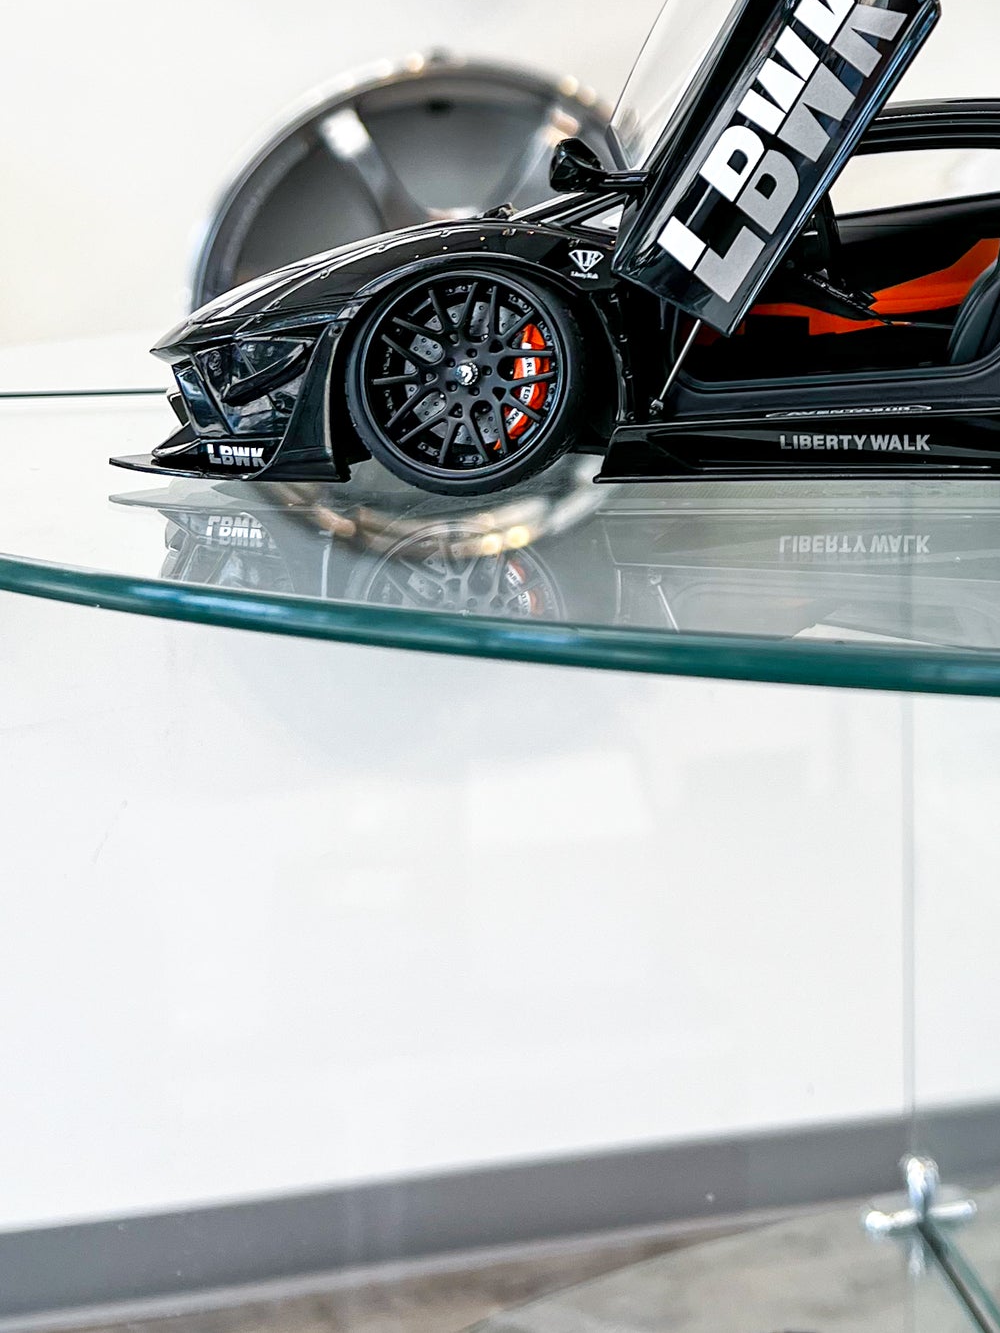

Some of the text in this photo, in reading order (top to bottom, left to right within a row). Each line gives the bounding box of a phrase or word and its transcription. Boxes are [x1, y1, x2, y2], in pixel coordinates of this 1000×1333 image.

[779, 434, 931, 451] LIBERTY WALK
[207, 443, 267, 467] LBWK
